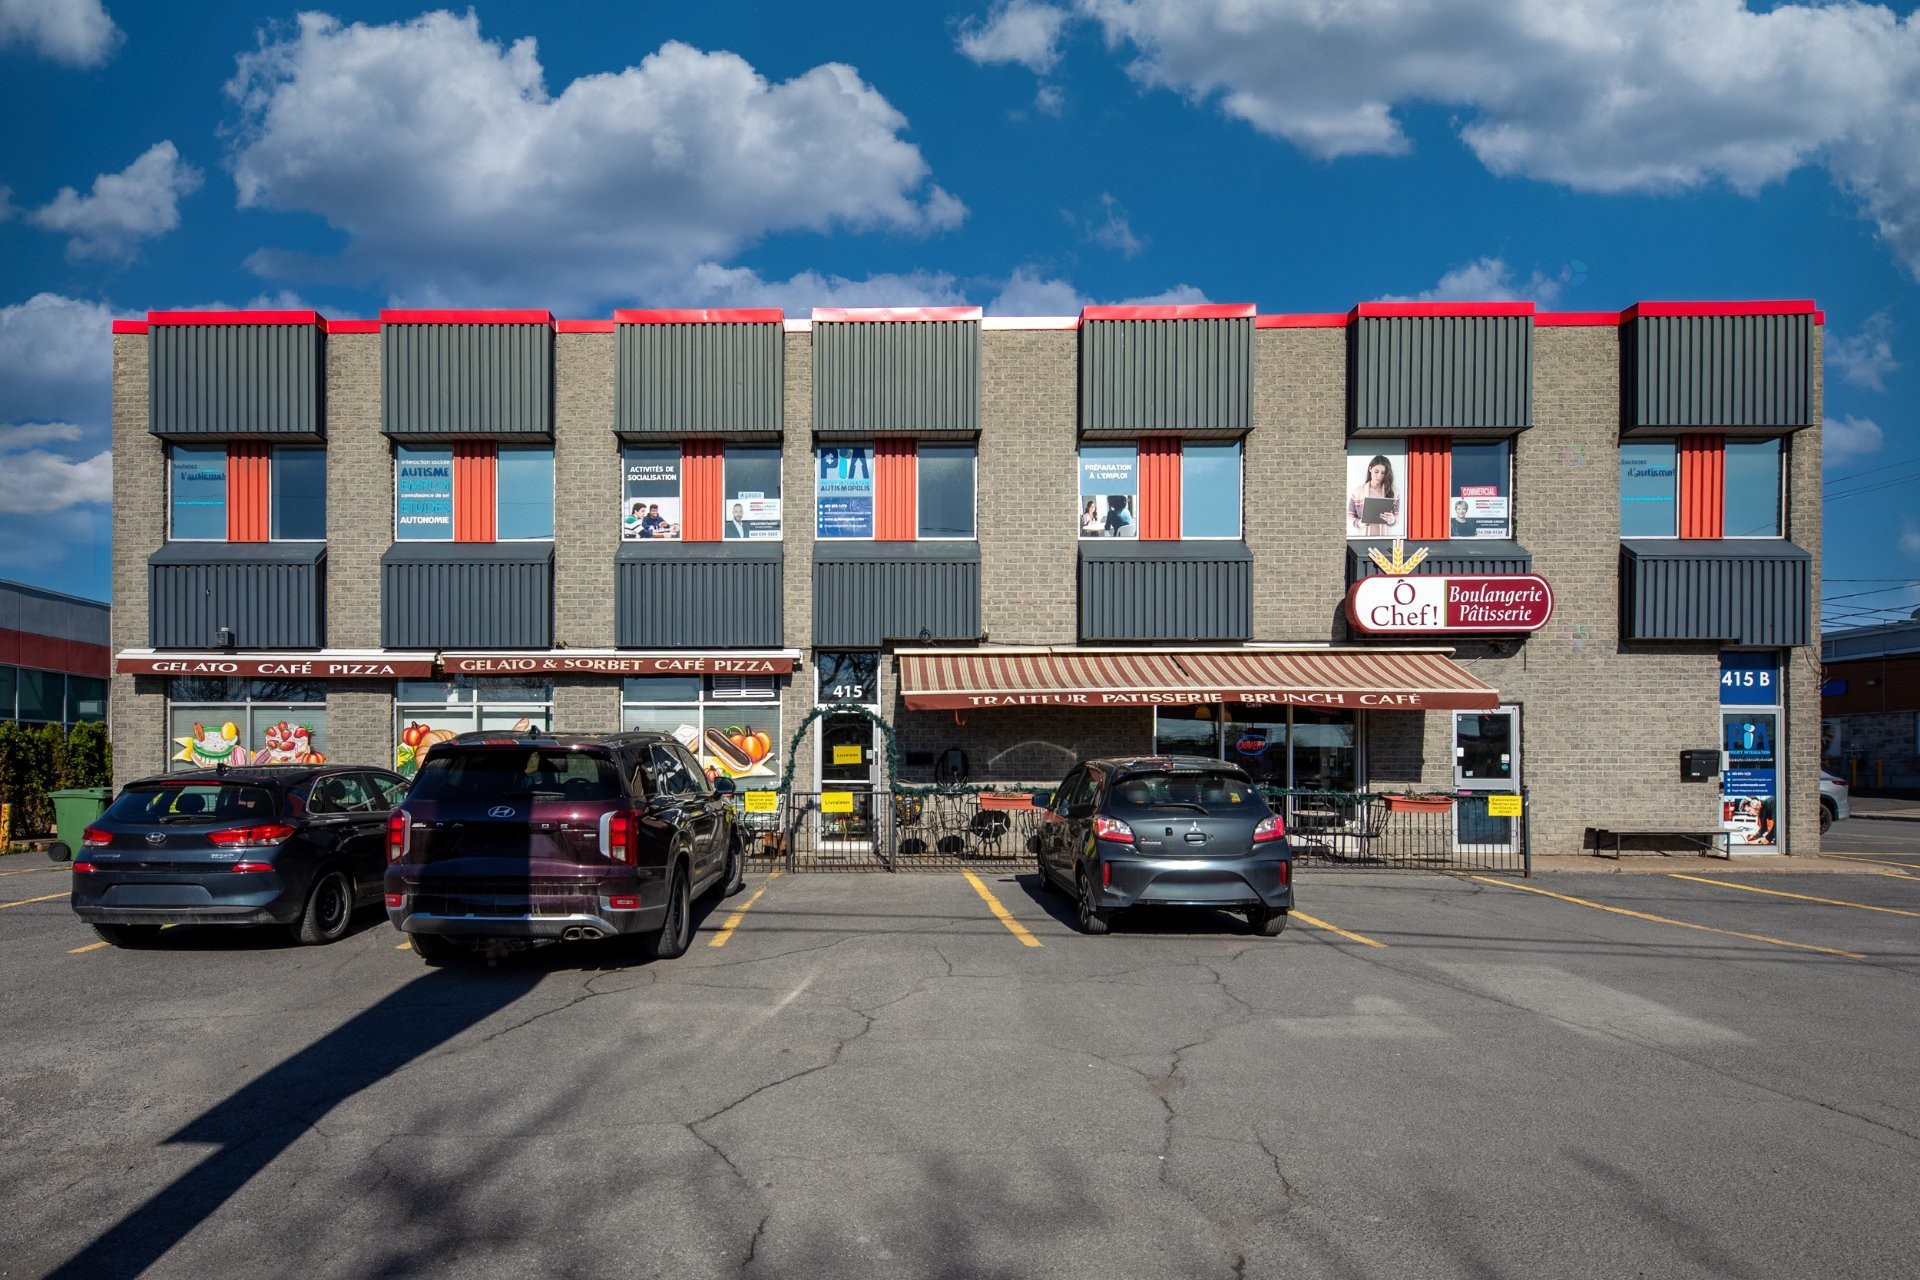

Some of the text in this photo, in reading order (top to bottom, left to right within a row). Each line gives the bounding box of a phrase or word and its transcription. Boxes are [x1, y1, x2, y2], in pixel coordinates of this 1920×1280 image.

[401, 467, 449, 477] AUTISME
[630, 464, 664, 473] ACTIVITÉS
[1084, 463, 1132, 471] PRÉPARATION
[1089, 471, 1095, 479] À
[401, 479, 450, 491] EMPLOI
[400, 497, 450, 513] ÉTUDES
[400, 516, 449, 524] AUTONOMIE
[1393, 579, 1416, 605] Ô
[1449, 583, 1543, 606] Boulangerie
[1459, 604, 1532, 622] Pâtisserie
[152, 661, 395, 675] GELATO CAFÉ PIZZA
[459, 658, 775, 672] GELATO & SORBET CAFÉ PIZZA
[1721, 671, 1770, 687] 415 B
[833, 684, 863, 698] 415
[1101, 693, 1223, 704] PATISSERIE
[1240, 693, 1345, 704] BRUNCH
[1359, 693, 1421, 706] CAFÉ
[1238, 740, 1266, 750] OUVERT
